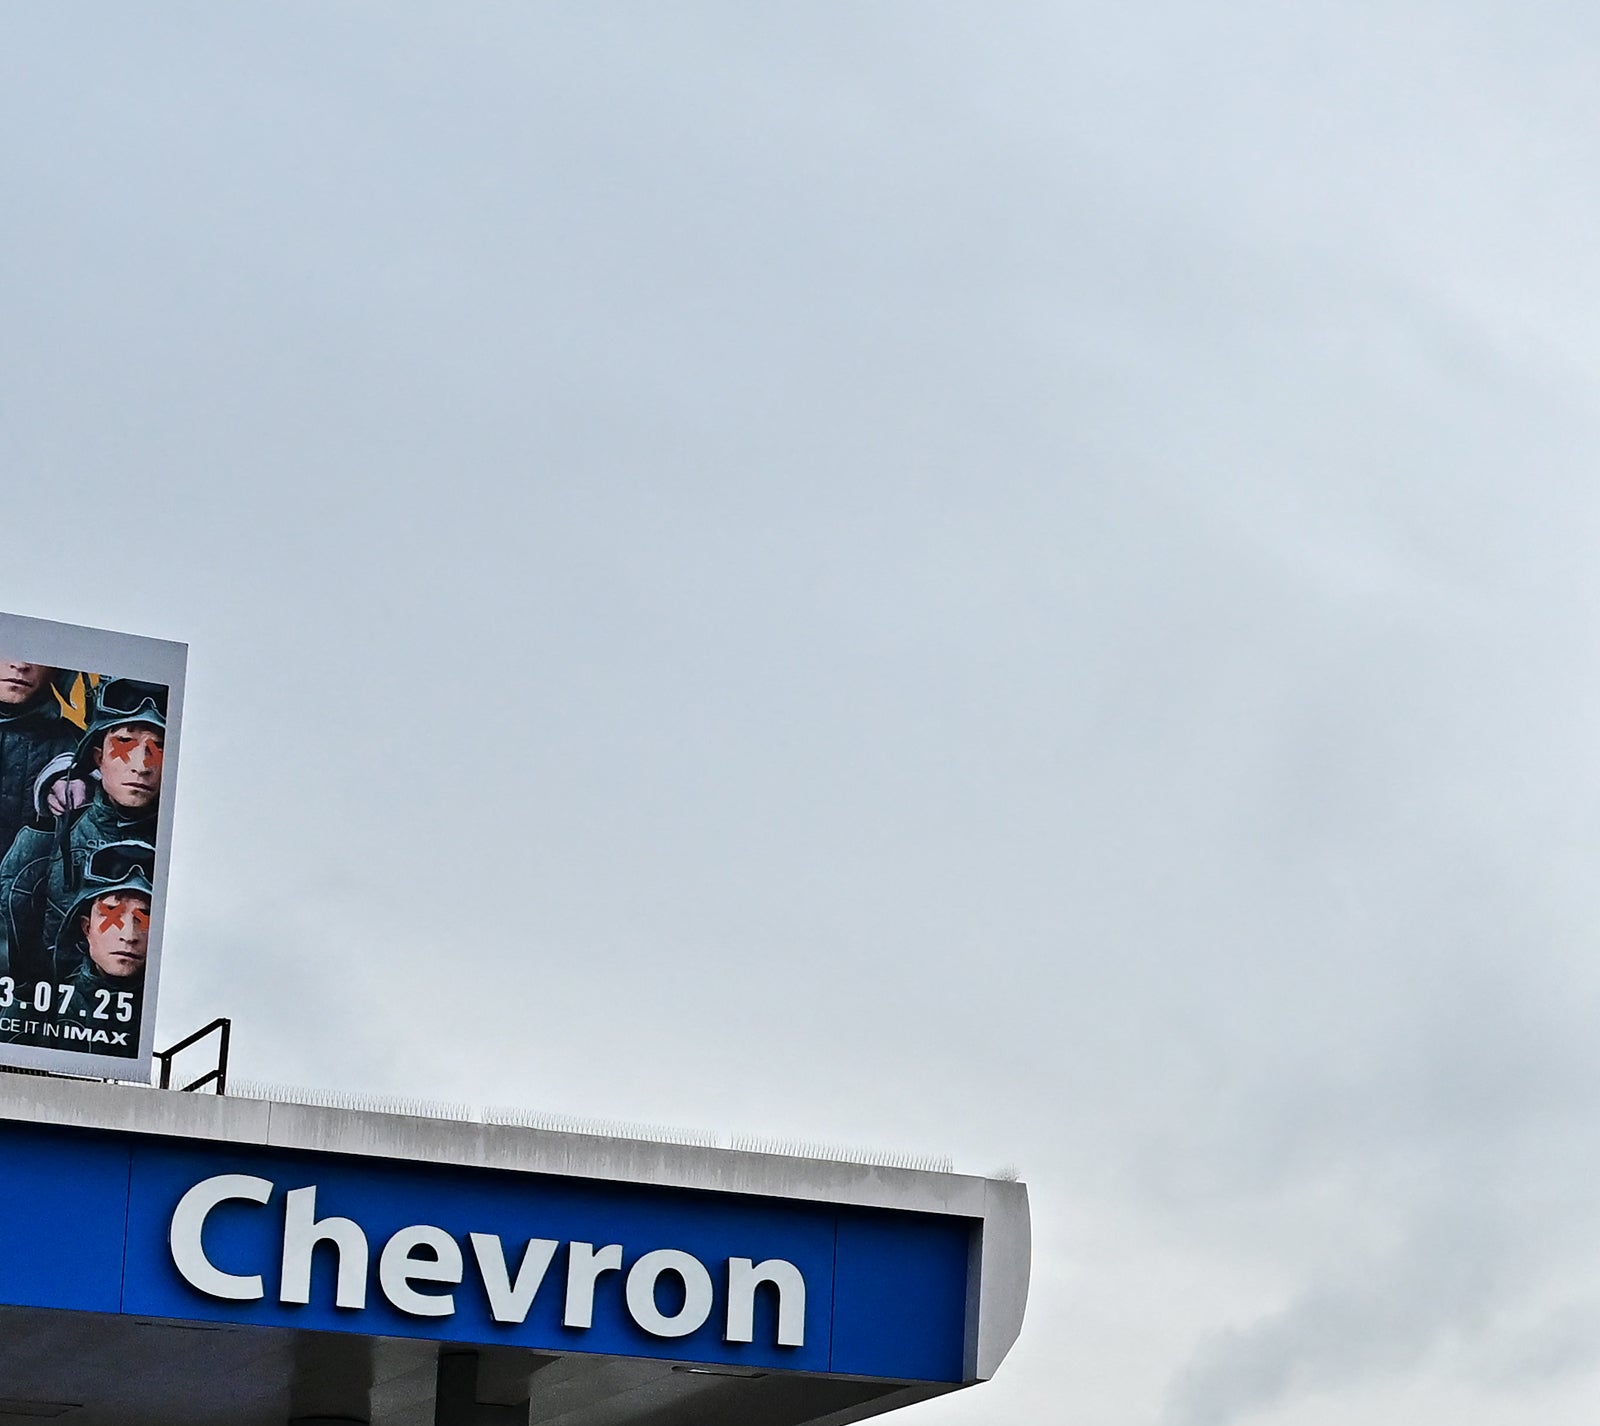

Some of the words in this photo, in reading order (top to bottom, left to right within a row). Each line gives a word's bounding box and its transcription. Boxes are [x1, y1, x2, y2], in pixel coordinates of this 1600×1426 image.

[24, 1021, 39, 1034] IT
[43, 1023, 59, 1037] IN
[63, 1026, 128, 1046] IMAX
[168, 1173, 807, 1348] Chevron
